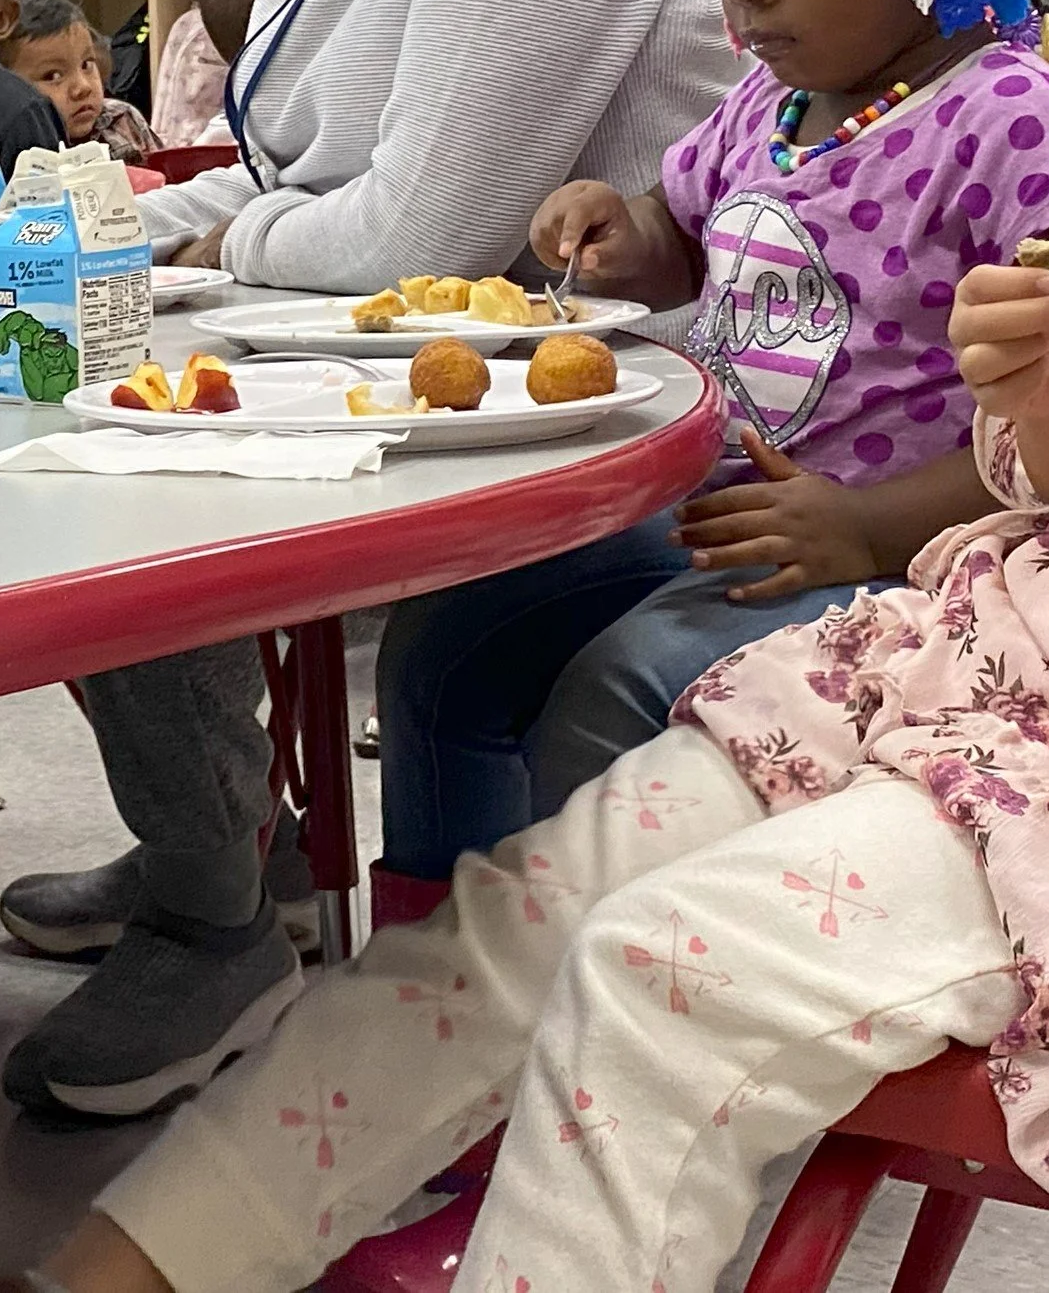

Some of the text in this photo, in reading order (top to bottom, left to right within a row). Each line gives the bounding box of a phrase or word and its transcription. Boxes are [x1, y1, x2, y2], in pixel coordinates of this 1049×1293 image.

[19, 221, 67, 234] Dairy
[13, 231, 56, 245] Pure
[8, 260, 35, 281] 1%
